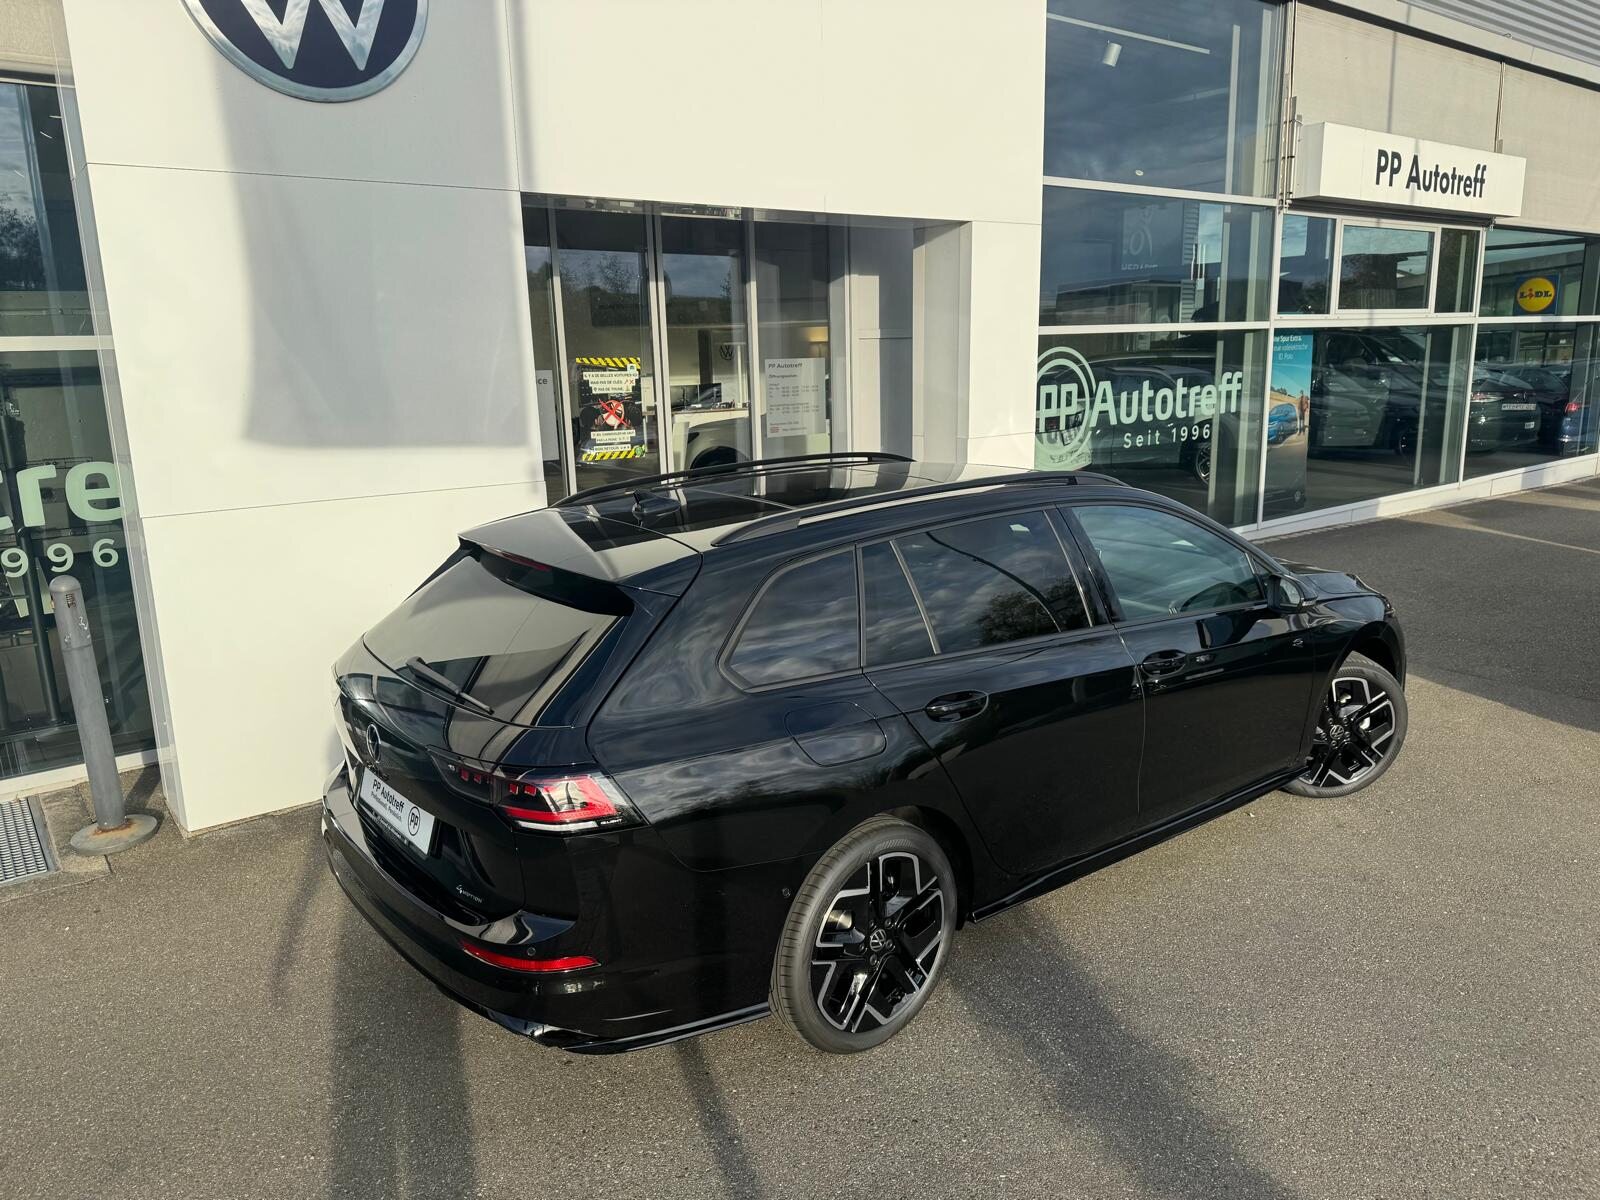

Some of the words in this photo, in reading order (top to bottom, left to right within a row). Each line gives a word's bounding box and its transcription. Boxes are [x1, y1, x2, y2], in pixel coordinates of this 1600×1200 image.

[1375, 149, 1402, 187] PP
[1405, 154, 1487, 198] Autotreff
[1040, 383, 1078, 433] PP
[1089, 371, 1243, 428] Autotreff
[1123, 429, 1161, 449] Seit
[1171, 423, 1211, 443] 1996
[372, 779, 382, 793] PP
[381, 786, 405, 813] Autotreff
[409, 812, 419, 830] PP
